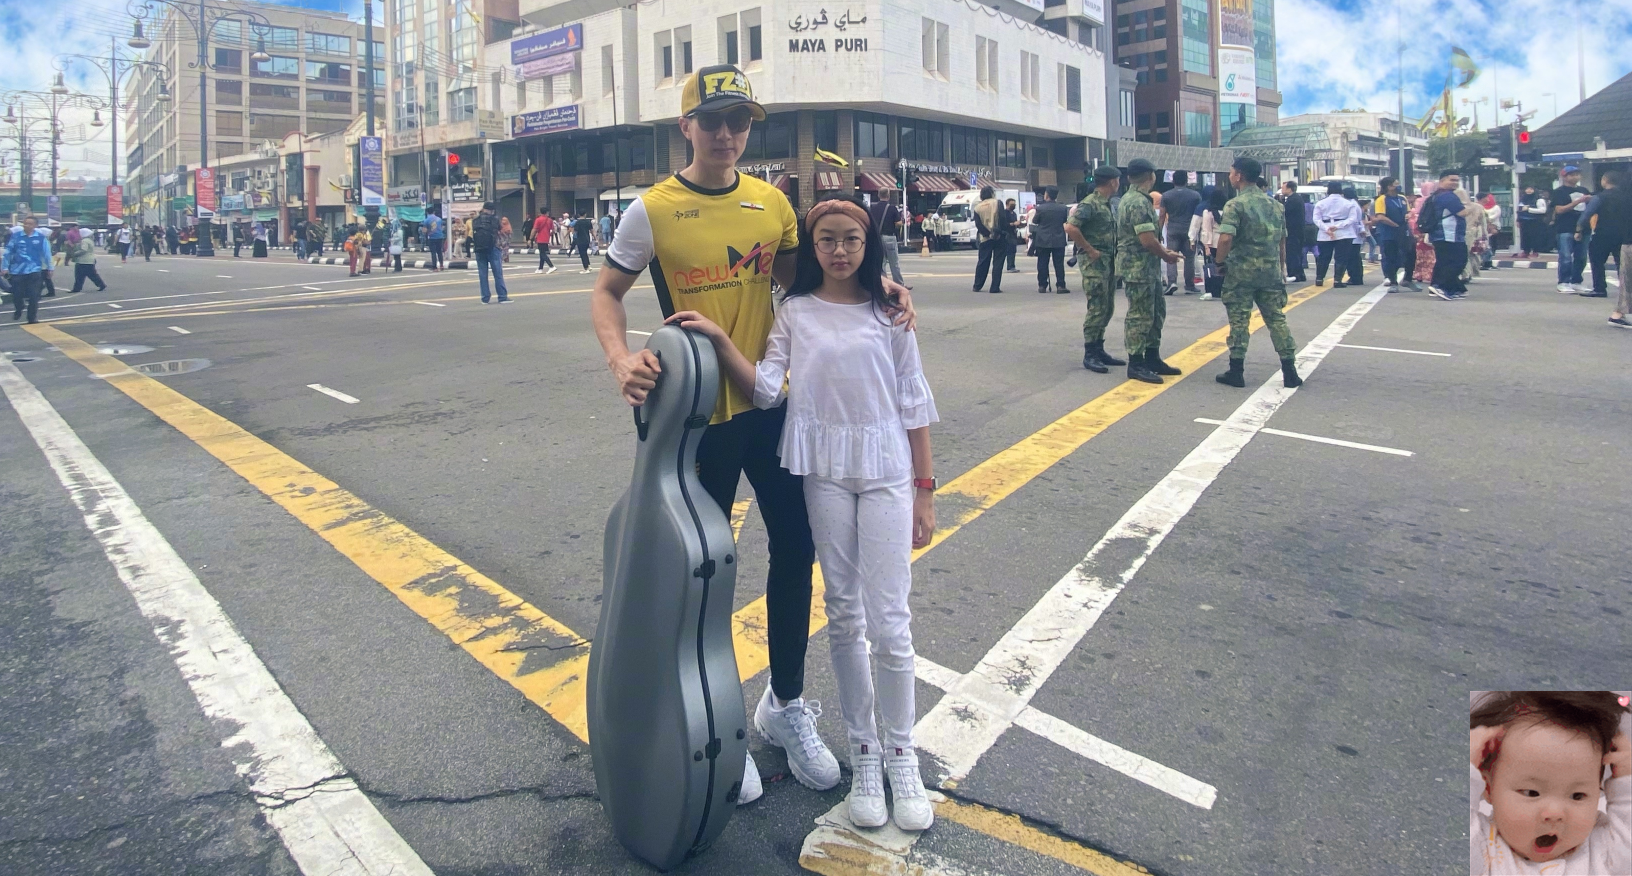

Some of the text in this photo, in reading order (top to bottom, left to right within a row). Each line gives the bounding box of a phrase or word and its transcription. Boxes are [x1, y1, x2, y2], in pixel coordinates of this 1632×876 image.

[788, 38, 868, 53] MAYA PURI
[677, 280, 742, 294] TRANSFORMATION
